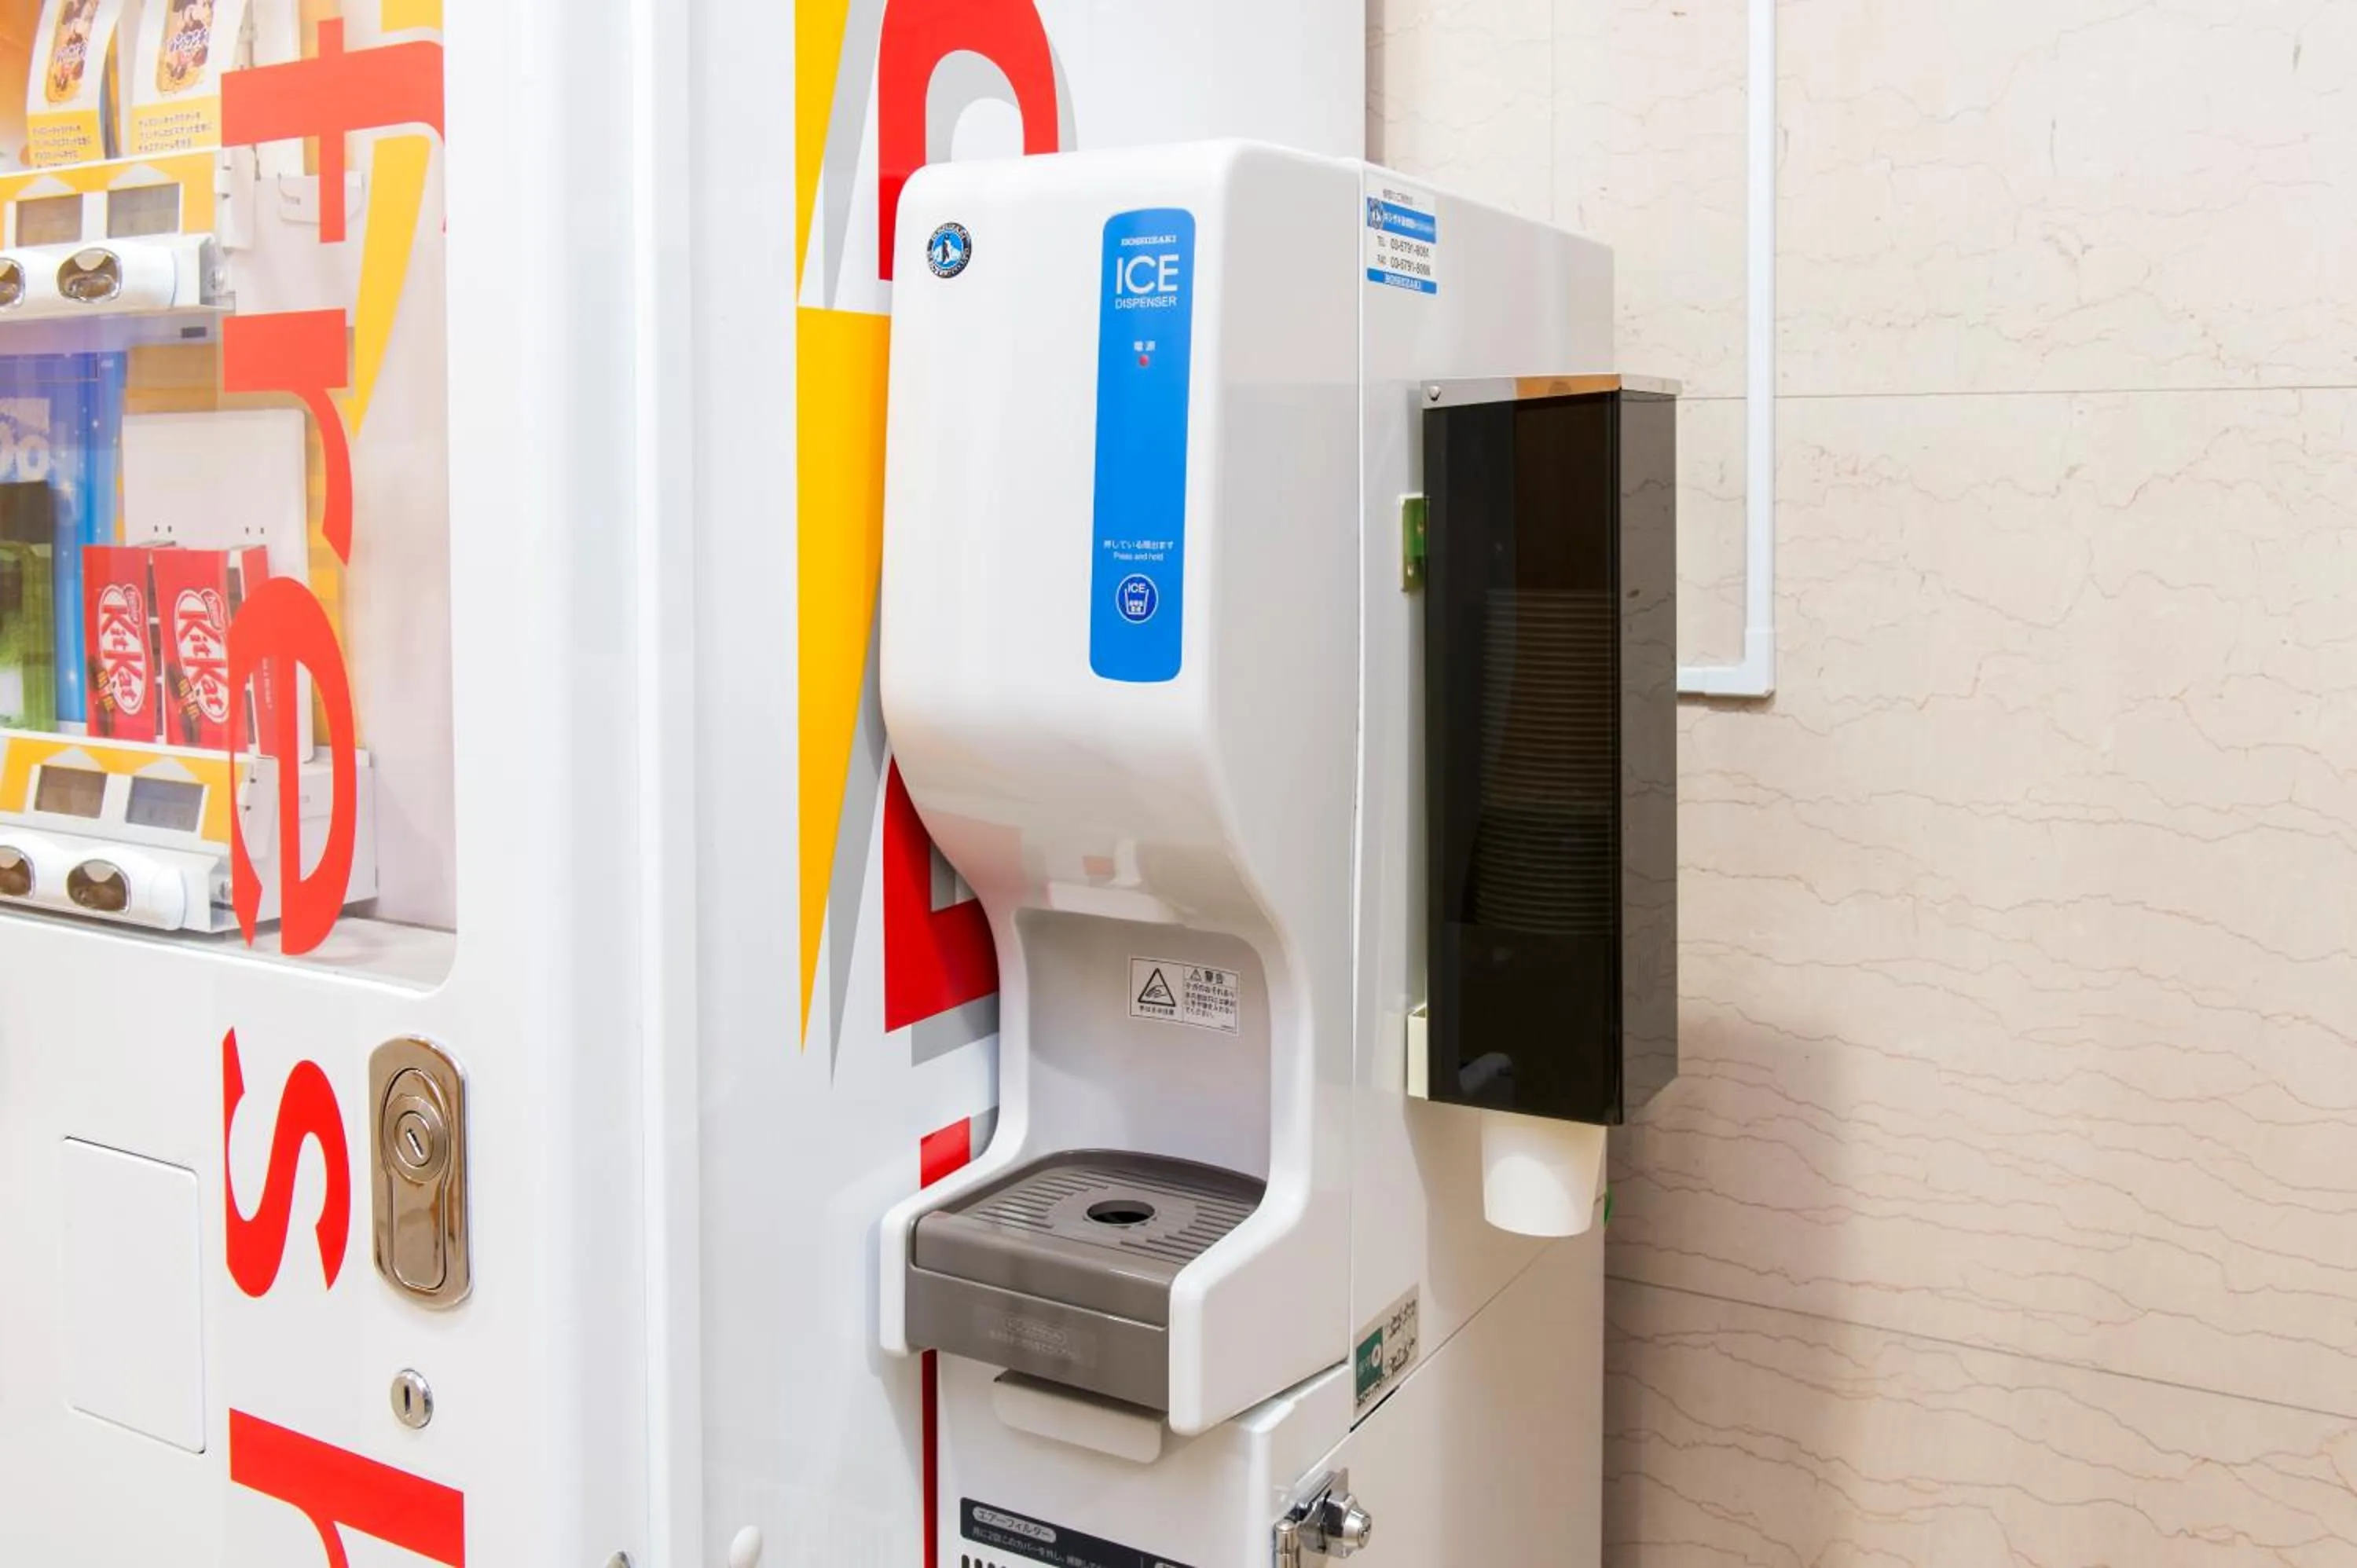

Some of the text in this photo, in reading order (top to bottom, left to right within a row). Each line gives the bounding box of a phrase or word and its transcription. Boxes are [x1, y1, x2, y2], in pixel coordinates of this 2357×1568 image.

[1116, 254, 1179, 295] ICE
[1115, 295, 1178, 310] DISPENSER
[1113, 551, 1133, 561] Press
[1149, 552, 1164, 561] hold
[1127, 582, 1146, 593] ICE
[101, 604, 145, 702] KitKat
[178, 610, 229, 709] KitKat
[978, 1510, 1051, 1537] エアーフィルター
